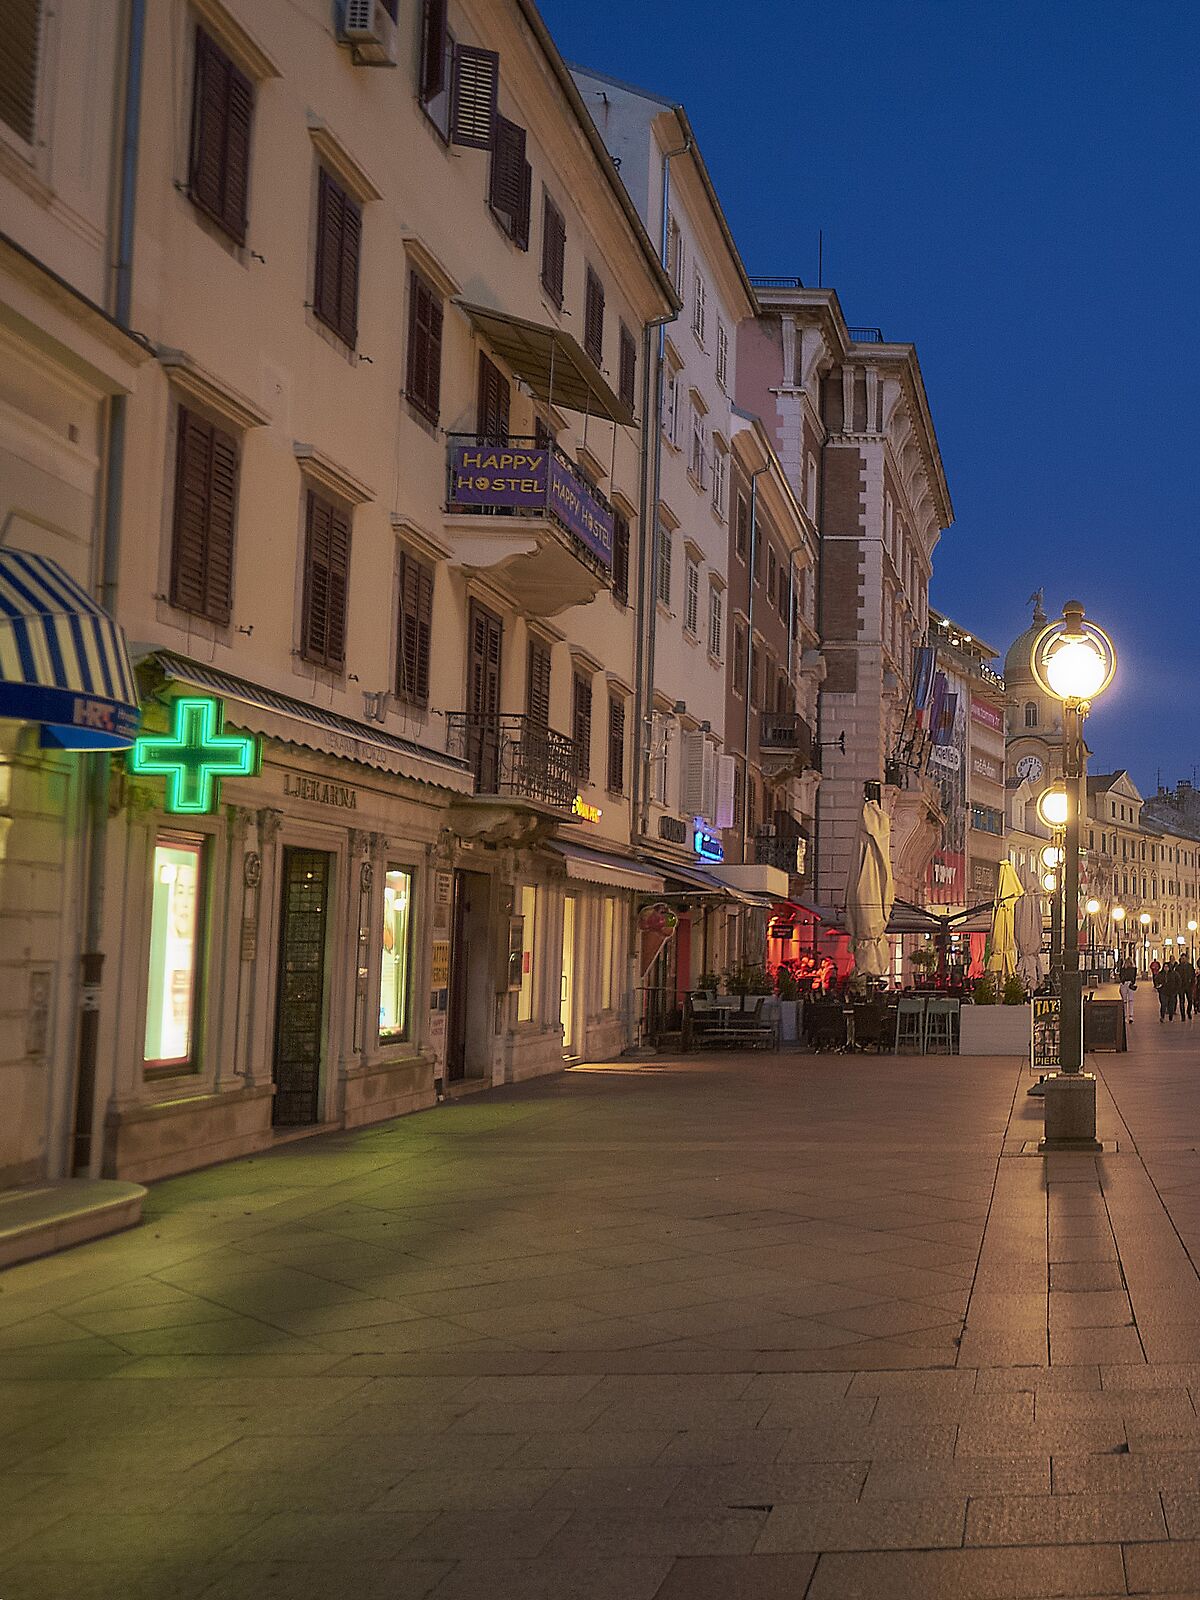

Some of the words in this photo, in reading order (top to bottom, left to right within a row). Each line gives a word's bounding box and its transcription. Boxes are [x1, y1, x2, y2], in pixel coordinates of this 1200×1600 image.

[463, 452, 543, 471] HAPPY
[457, 475, 545, 493] HOSTEL
[552, 474, 580, 517] HAPPY
[581, 505, 611, 550] HOSTEL
[283, 773, 357, 809] LJEKARNA
